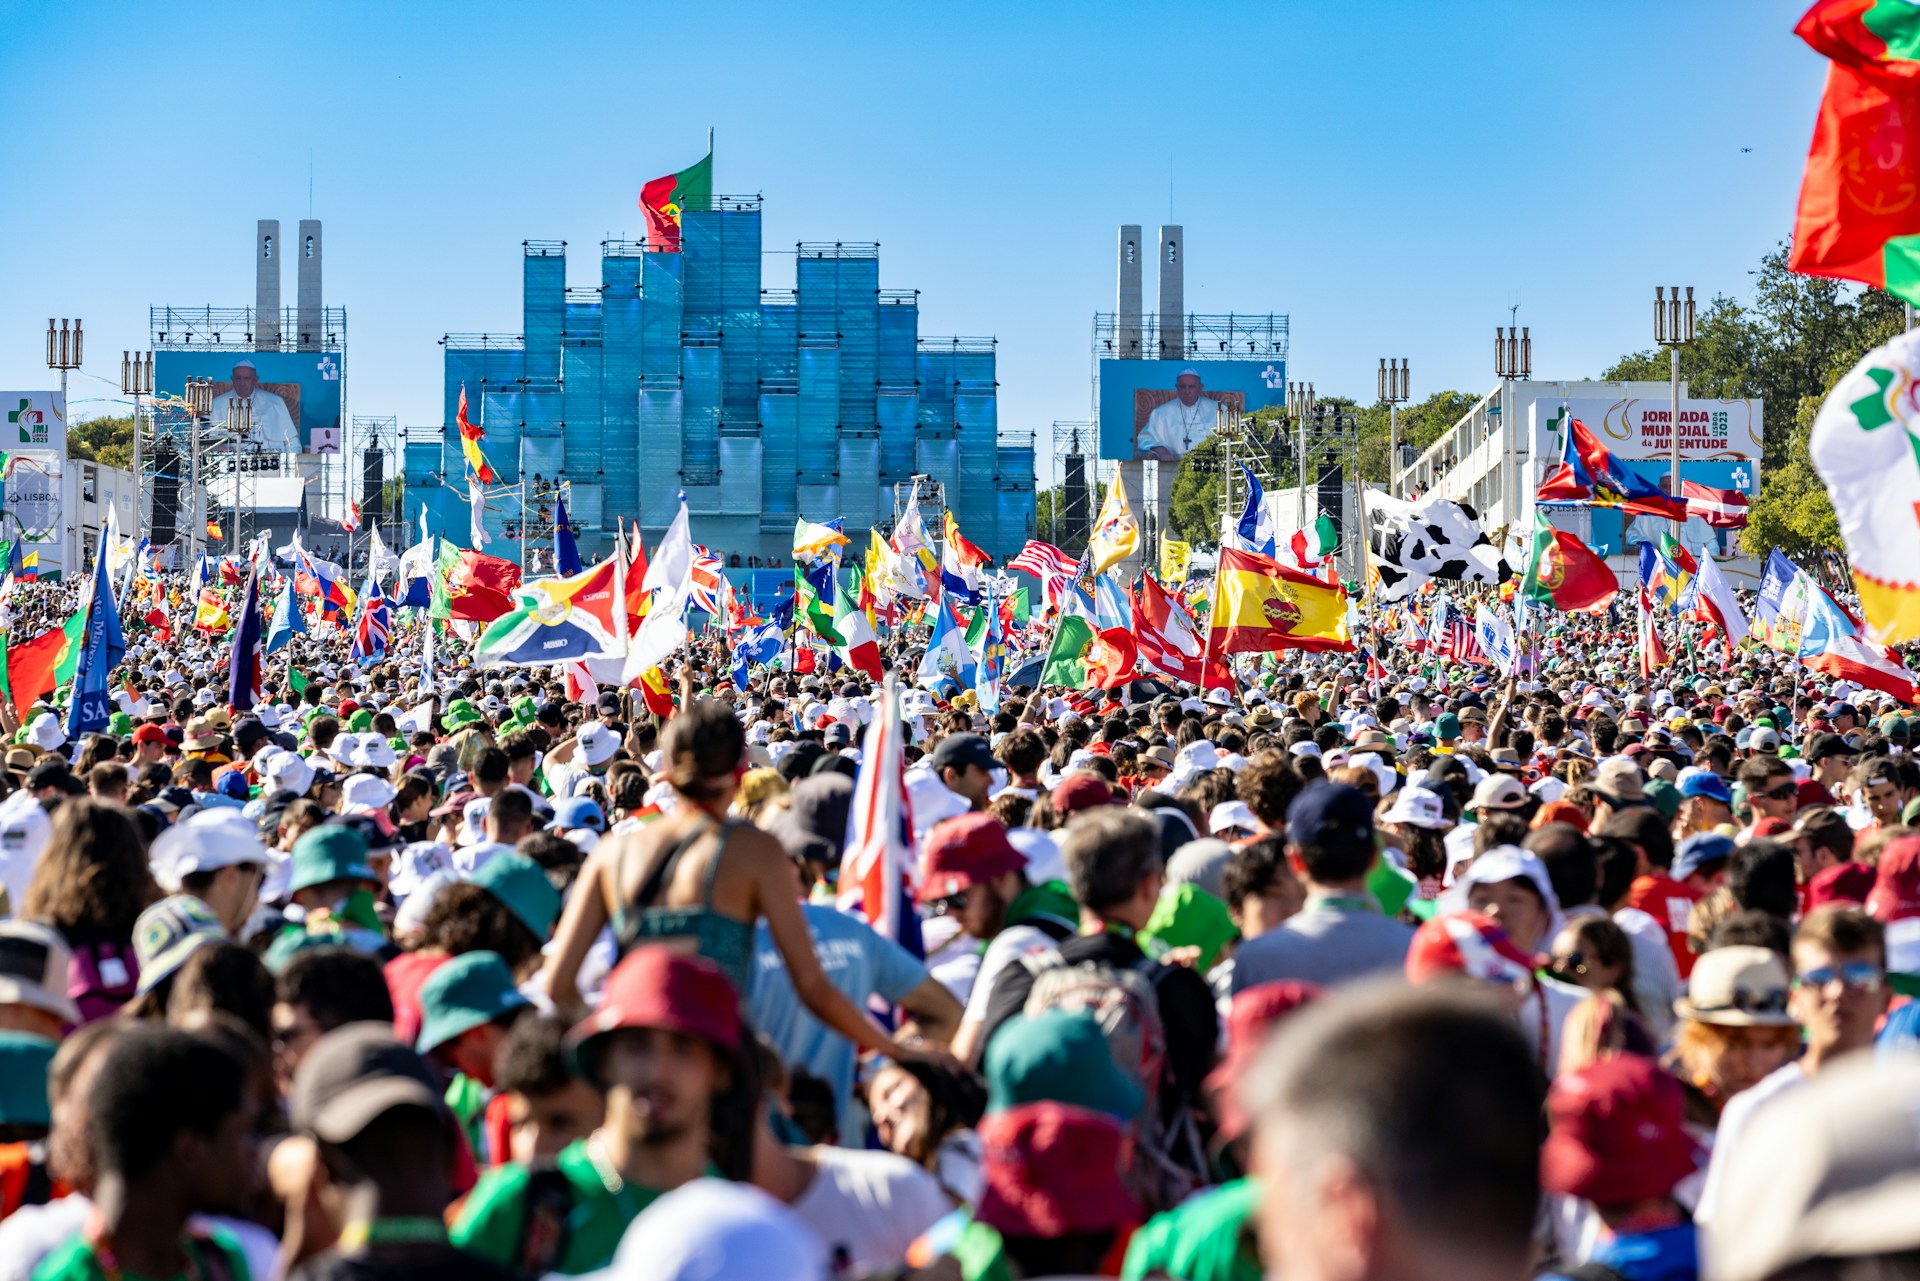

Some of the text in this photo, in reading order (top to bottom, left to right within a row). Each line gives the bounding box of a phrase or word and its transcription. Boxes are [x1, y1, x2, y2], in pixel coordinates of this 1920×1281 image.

[32, 424, 48, 433] JMJ
[1719, 411, 1728, 437] 2023
[1642, 438, 1728, 449] da JUENTUDE
[24, 493, 58, 501] LISBOA
